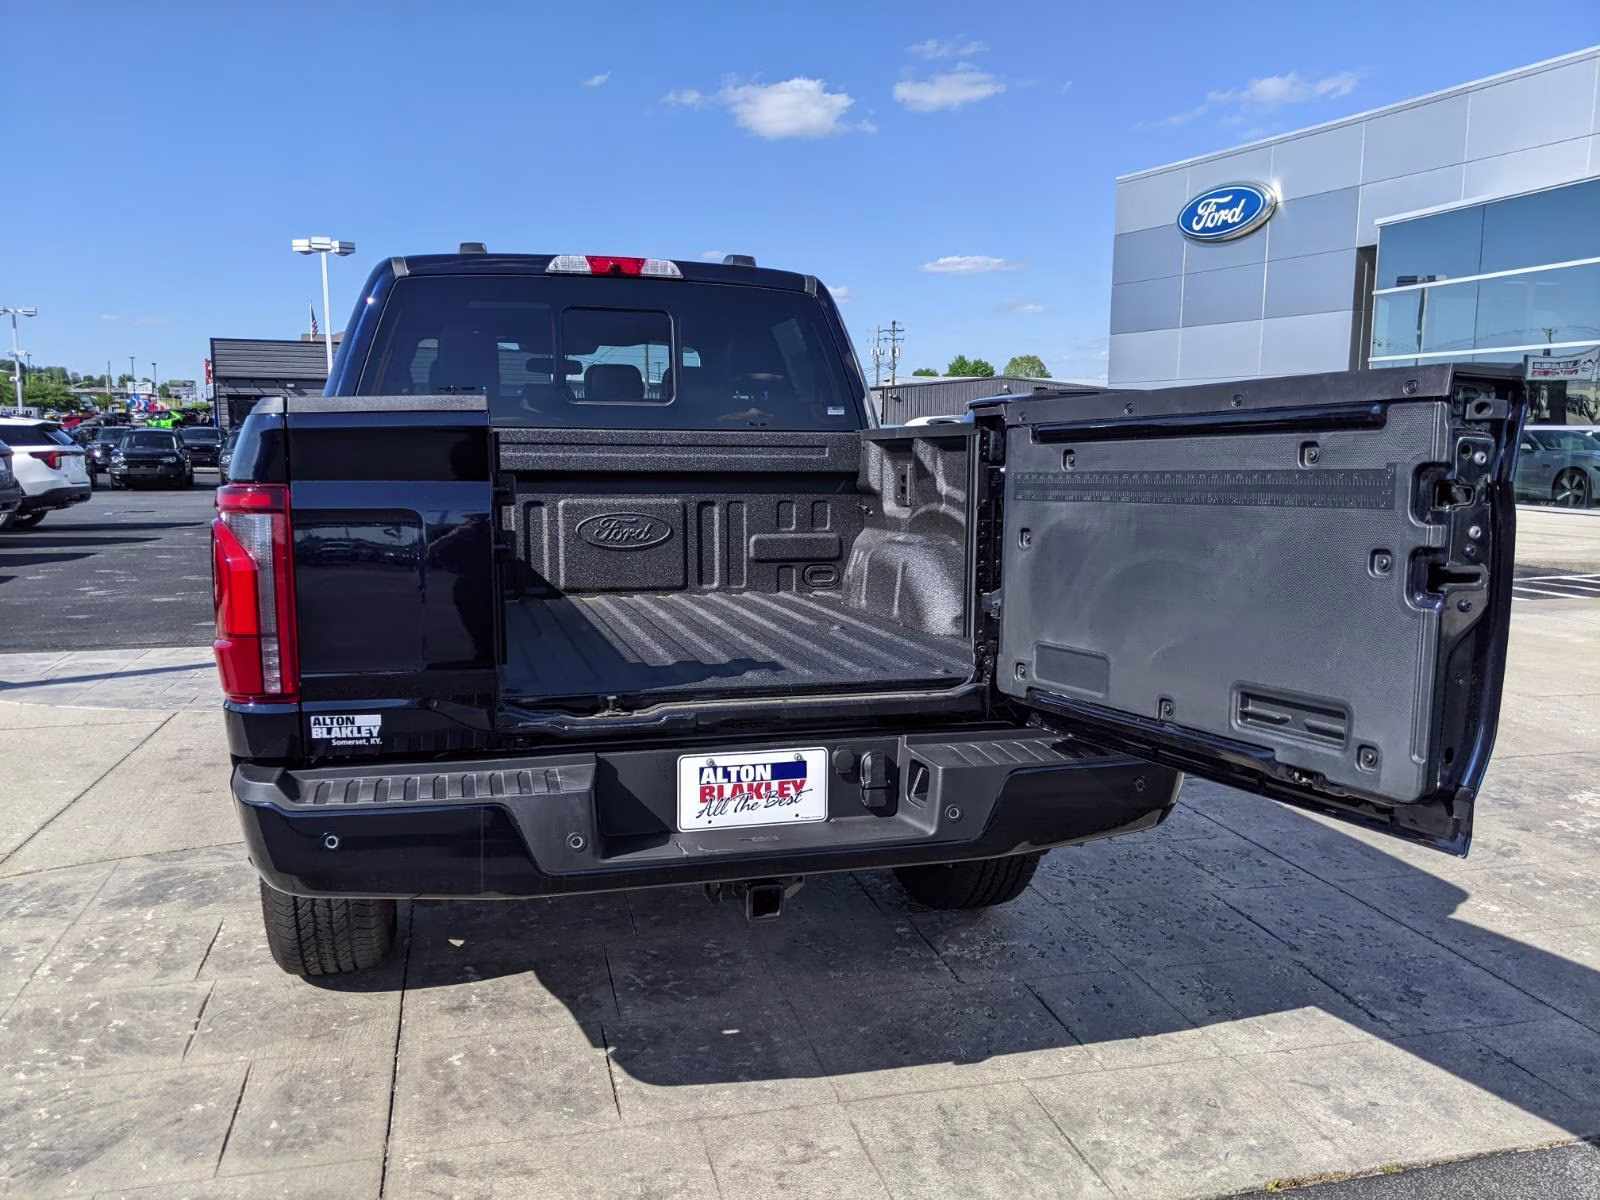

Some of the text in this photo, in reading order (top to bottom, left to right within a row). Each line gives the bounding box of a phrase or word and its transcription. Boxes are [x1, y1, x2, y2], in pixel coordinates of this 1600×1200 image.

[1192, 195, 1247, 231] Ford
[593, 517, 652, 541] Ford
[311, 726, 380, 738] BLAKLEY
[312, 716, 355, 726] ALTON
[700, 764, 772, 785] ALTON
[695, 787, 813, 819] All The Best
[699, 779, 807, 804] BLAKLEY
